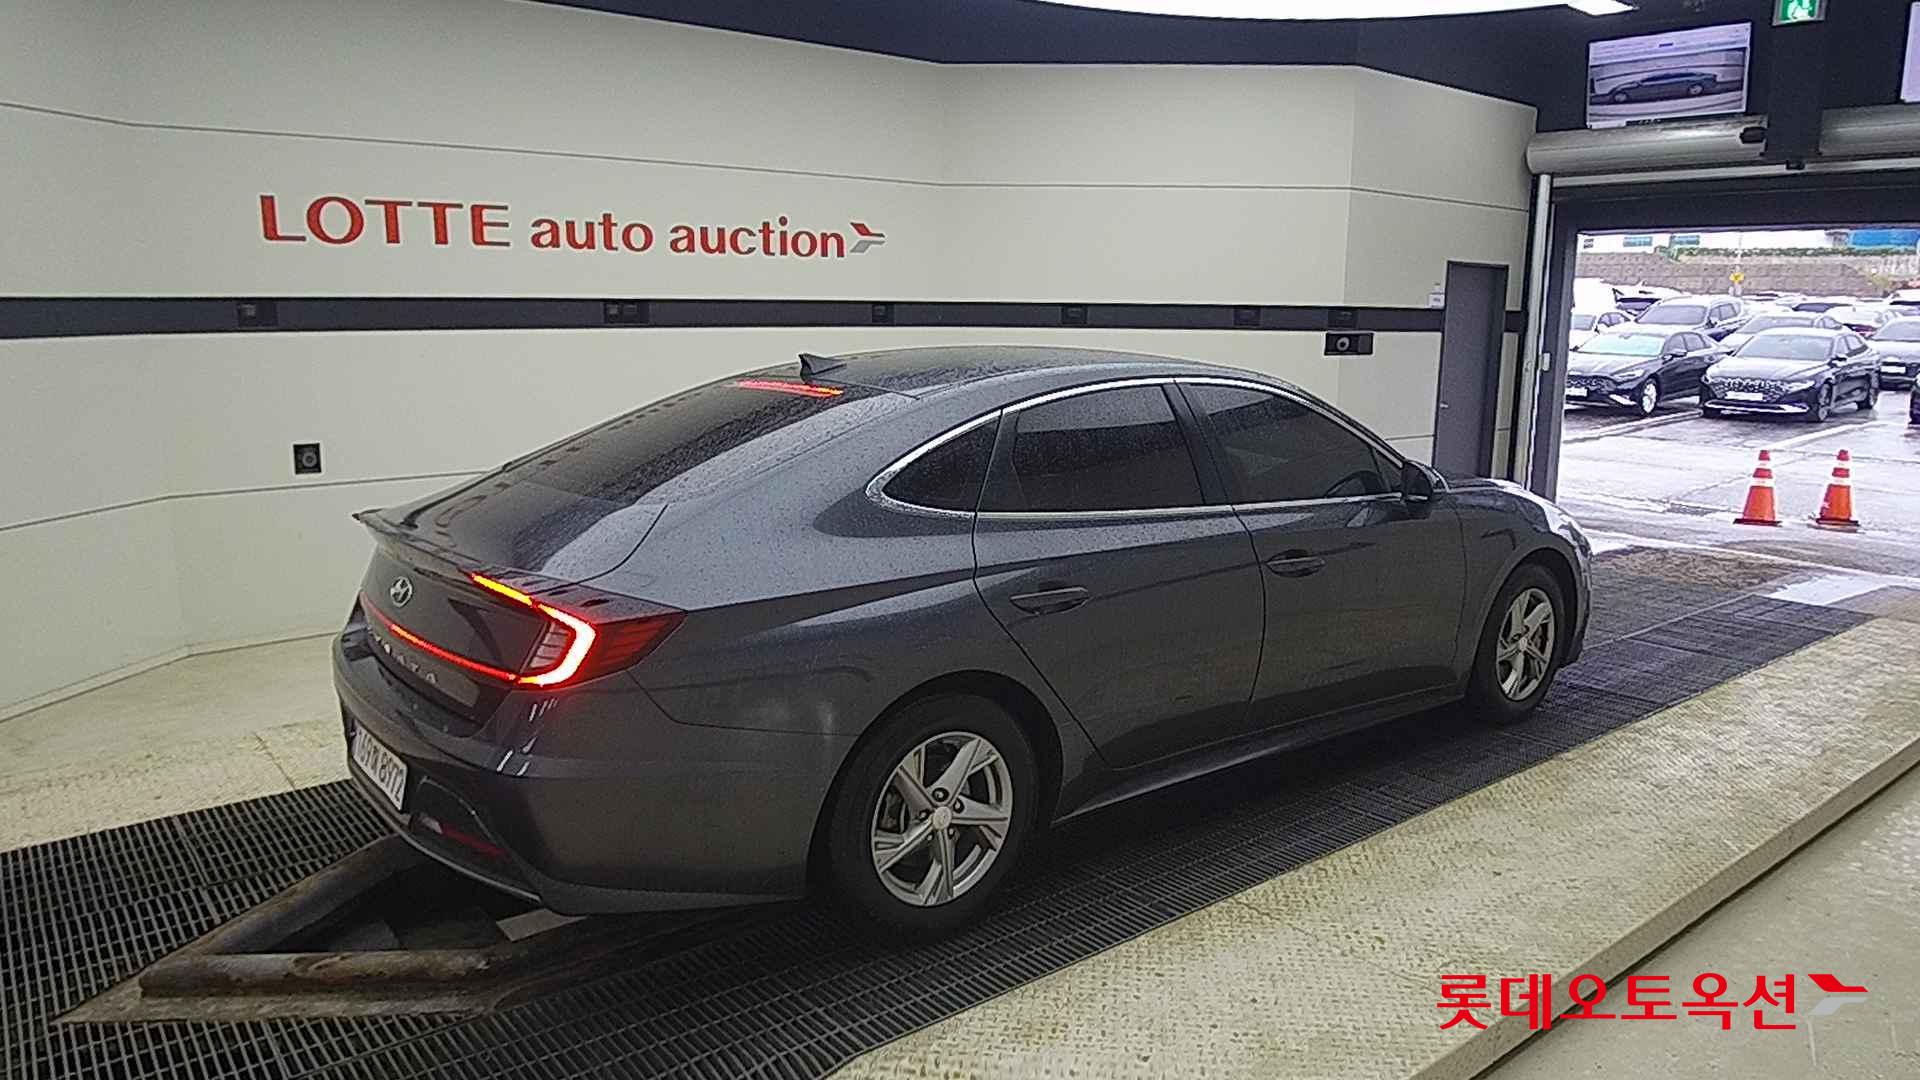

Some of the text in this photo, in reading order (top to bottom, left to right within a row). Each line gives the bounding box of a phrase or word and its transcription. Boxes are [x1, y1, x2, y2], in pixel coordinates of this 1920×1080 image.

[259, 195, 846, 258] LOTTE auto auction
